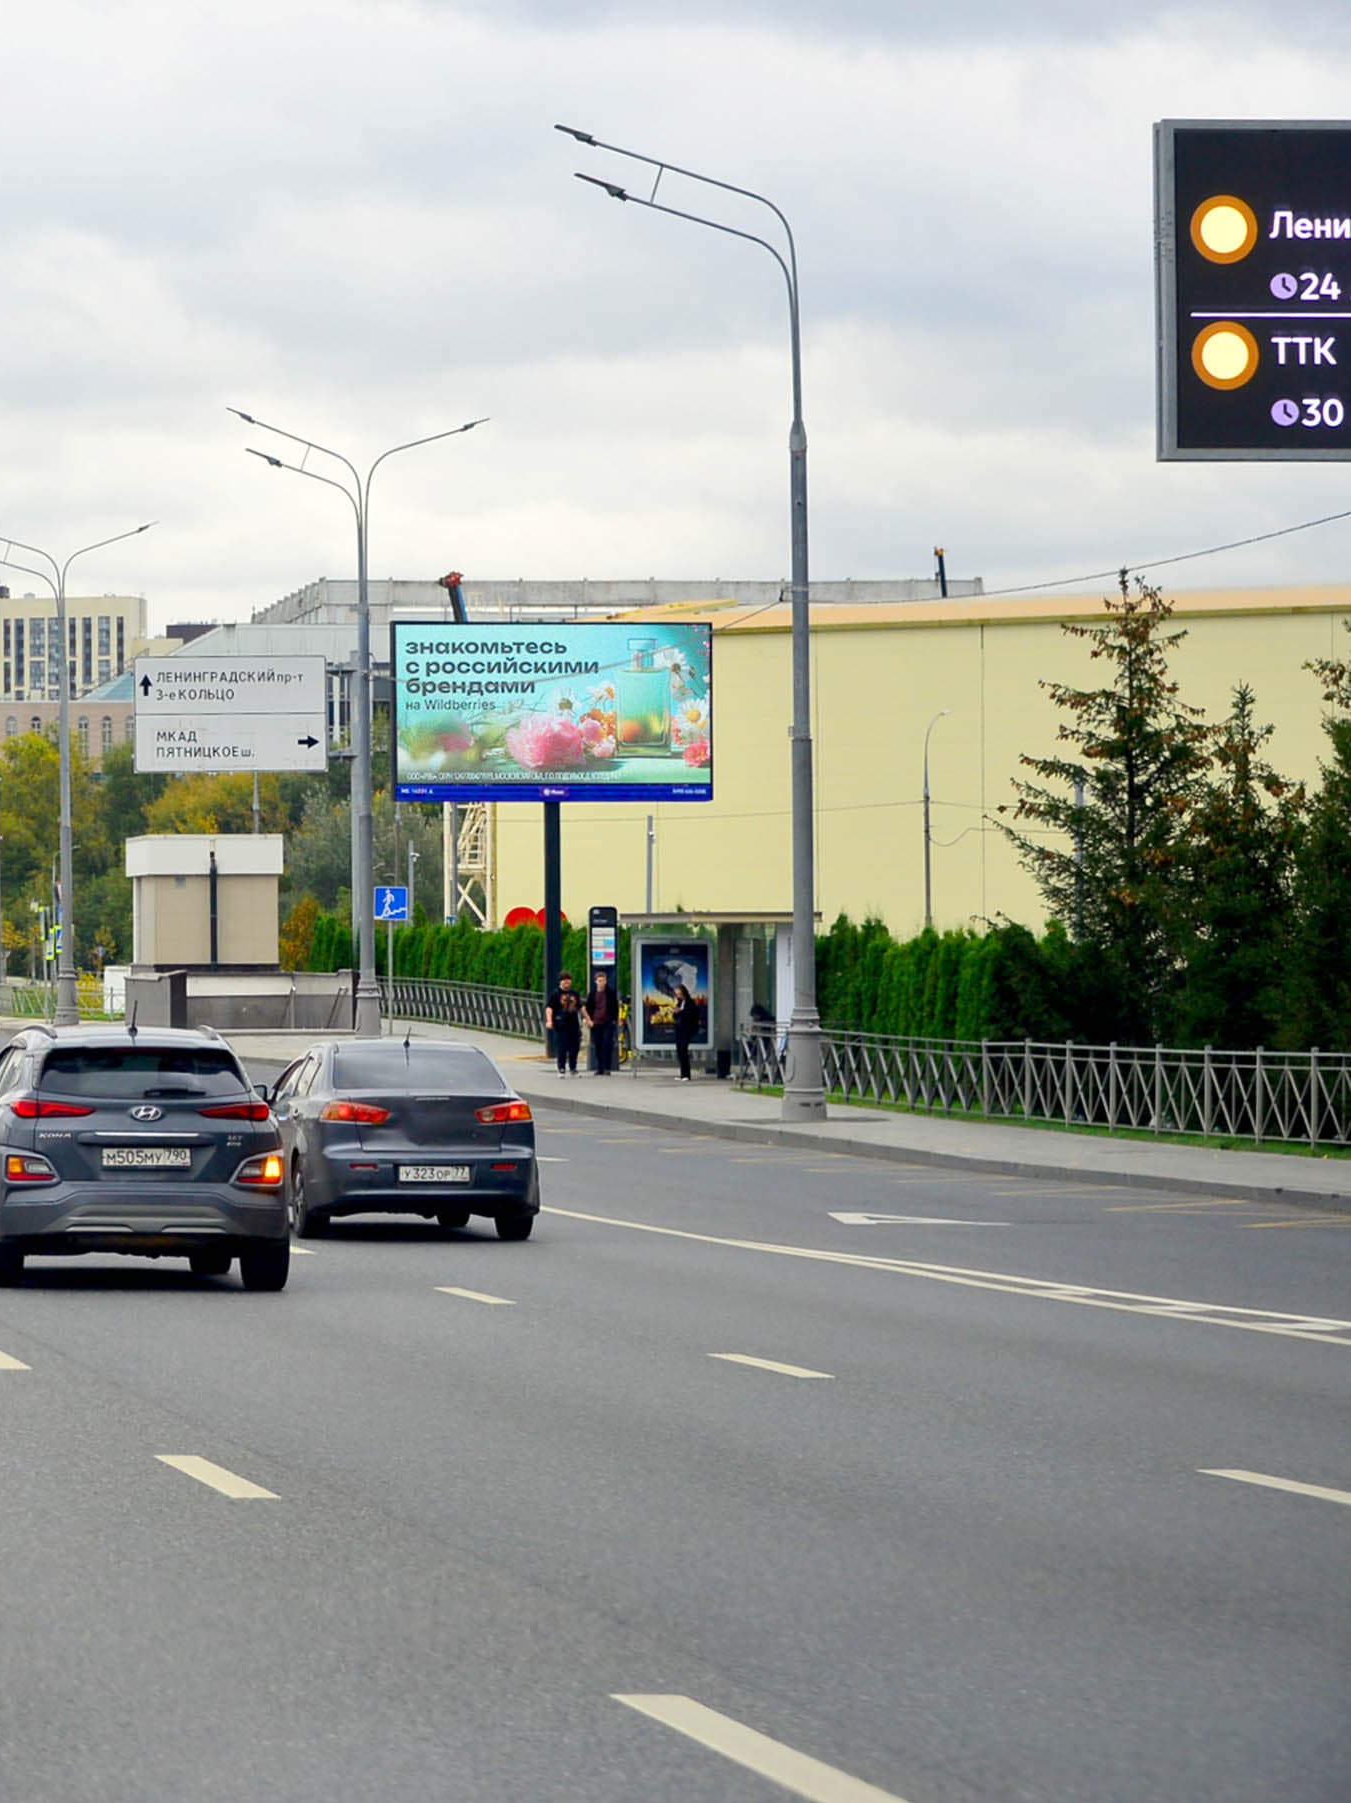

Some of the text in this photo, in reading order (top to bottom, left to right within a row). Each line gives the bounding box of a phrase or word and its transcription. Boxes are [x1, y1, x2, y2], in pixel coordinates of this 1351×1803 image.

[1269, 210, 1351, 239] Лени
[1299, 272, 1341, 301] 24
[1270, 337, 1337, 365] ТТК
[1301, 398, 1345, 427] 30
[405, 641, 568, 655] знакомьтесь
[405, 657, 600, 677] с российскими
[156, 669, 304, 685] ЛЕНИНГРАДСКИЙ пр-т
[156, 689, 235, 702] 3-е КОЛЬЦО
[405, 678, 536, 697] брендами
[405, 699, 497, 711] на Wildberries
[156, 731, 198, 743] МКАД
[156, 747, 239, 759] ПЯТНИЦКОЕ
[166, 1150, 187, 1160] 790
